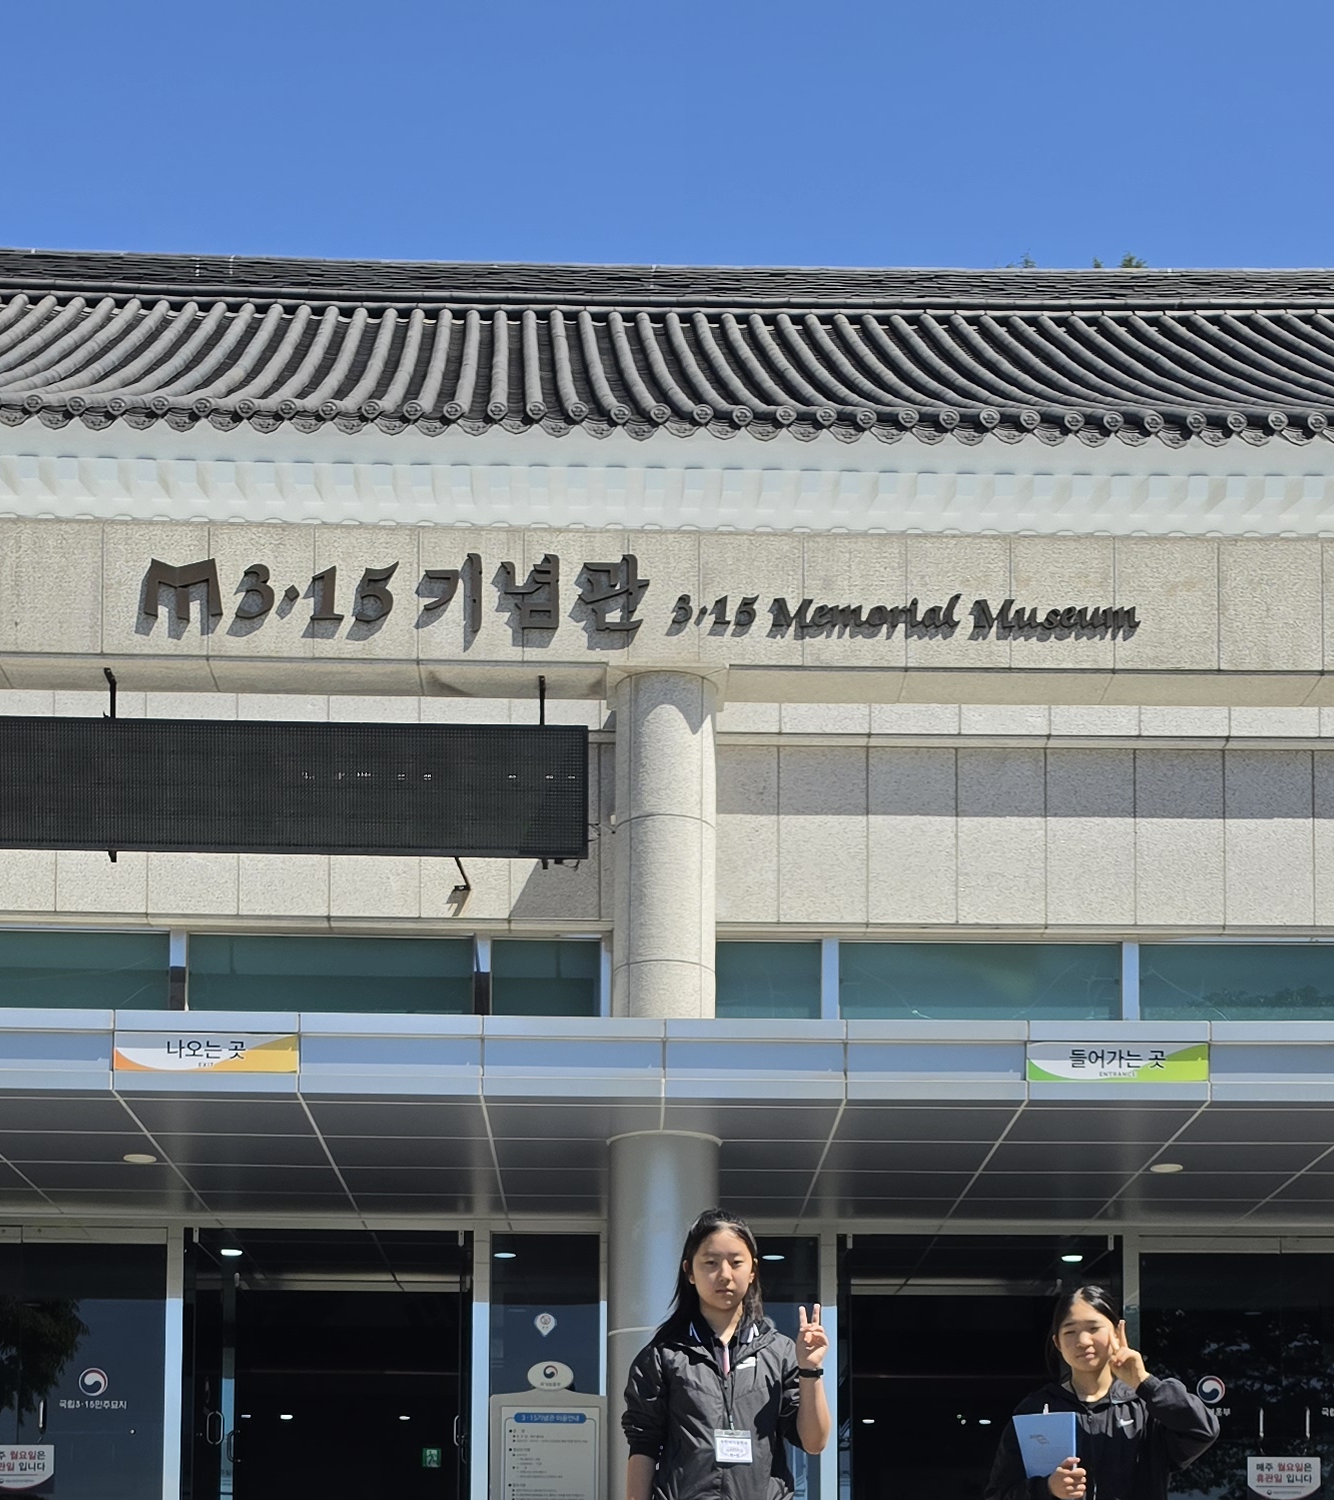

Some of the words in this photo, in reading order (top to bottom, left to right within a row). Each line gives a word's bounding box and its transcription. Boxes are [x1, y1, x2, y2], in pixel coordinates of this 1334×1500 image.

[768, 592, 962, 629] Memorial
[971, 598, 1141, 630] Museum
[166, 1039, 223, 1060] 나오는
[228, 1040, 247, 1060] 곳
[1069, 1048, 1143, 1069] 들어가는
[1148, 1050, 1166, 1069] 곳
[10, 1450, 46, 1460] 월요일은
[19, 1462, 46, 1471] 입니다
[1256, 1462, 1274, 1472] 매주
[1278, 1462, 1313, 1472] 월요일은
[1257, 1473, 1283, 1483] 휴관일
[1286, 1473, 1313, 1483] 입니다
